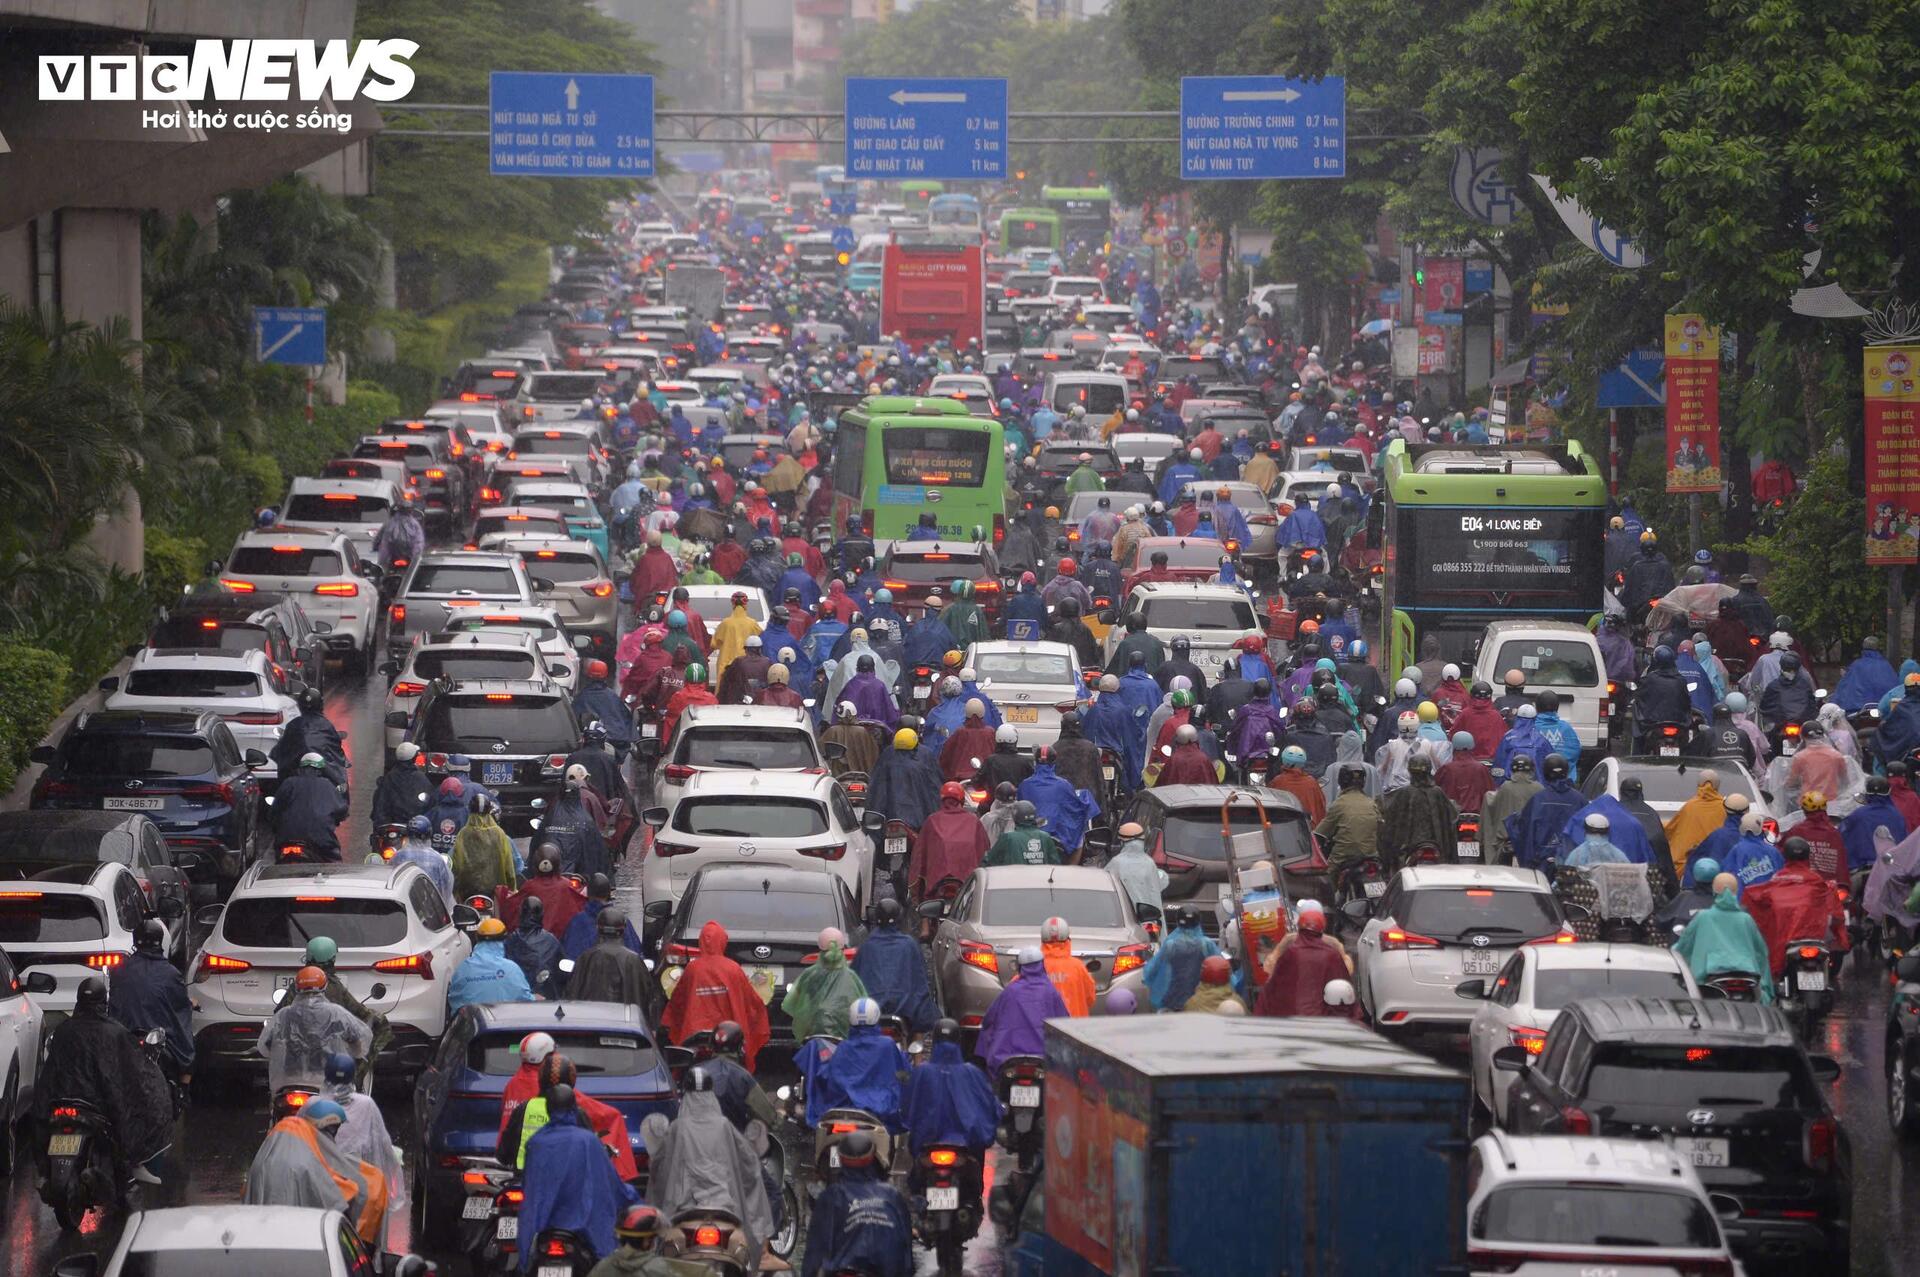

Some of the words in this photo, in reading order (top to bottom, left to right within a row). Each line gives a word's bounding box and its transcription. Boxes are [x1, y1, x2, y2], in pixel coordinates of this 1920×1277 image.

[516, 113, 538, 125] GIAO
[984, 118, 999, 129] km
[1266, 117, 1295, 128] CHINH
[1306, 115, 1320, 128] 0.7
[1323, 115, 1339, 127] km
[516, 134, 538, 146] GIAO
[617, 136, 631, 148] 2.5
[635, 136, 650, 148] km
[875, 138, 897, 150] GIAO
[984, 139, 999, 150] km
[1208, 138, 1231, 150] GIAO
[1313, 137, 1320, 148] 3
[1323, 136, 1339, 148] km
[635, 158, 650, 169] km
[984, 160, 999, 171] km
[1236, 157, 1255, 170] TUY
[1323, 157, 1339, 169] km
[927, 263, 945, 272] CITY
[946, 264, 967, 272] TOUR
[1731, 495, 1739, 508] 5
[1461, 517, 1483, 531] E04
[1495, 519, 1521, 530] LONG
[1443, 563, 1459, 572] 0866
[1460, 563, 1472, 572] 355
[1473, 563, 1485, 573] 222
[1551, 565, 1571, 574] VINBUS
[490, 764, 507, 773] 80A
[1471, 951, 1491, 961] 30G
